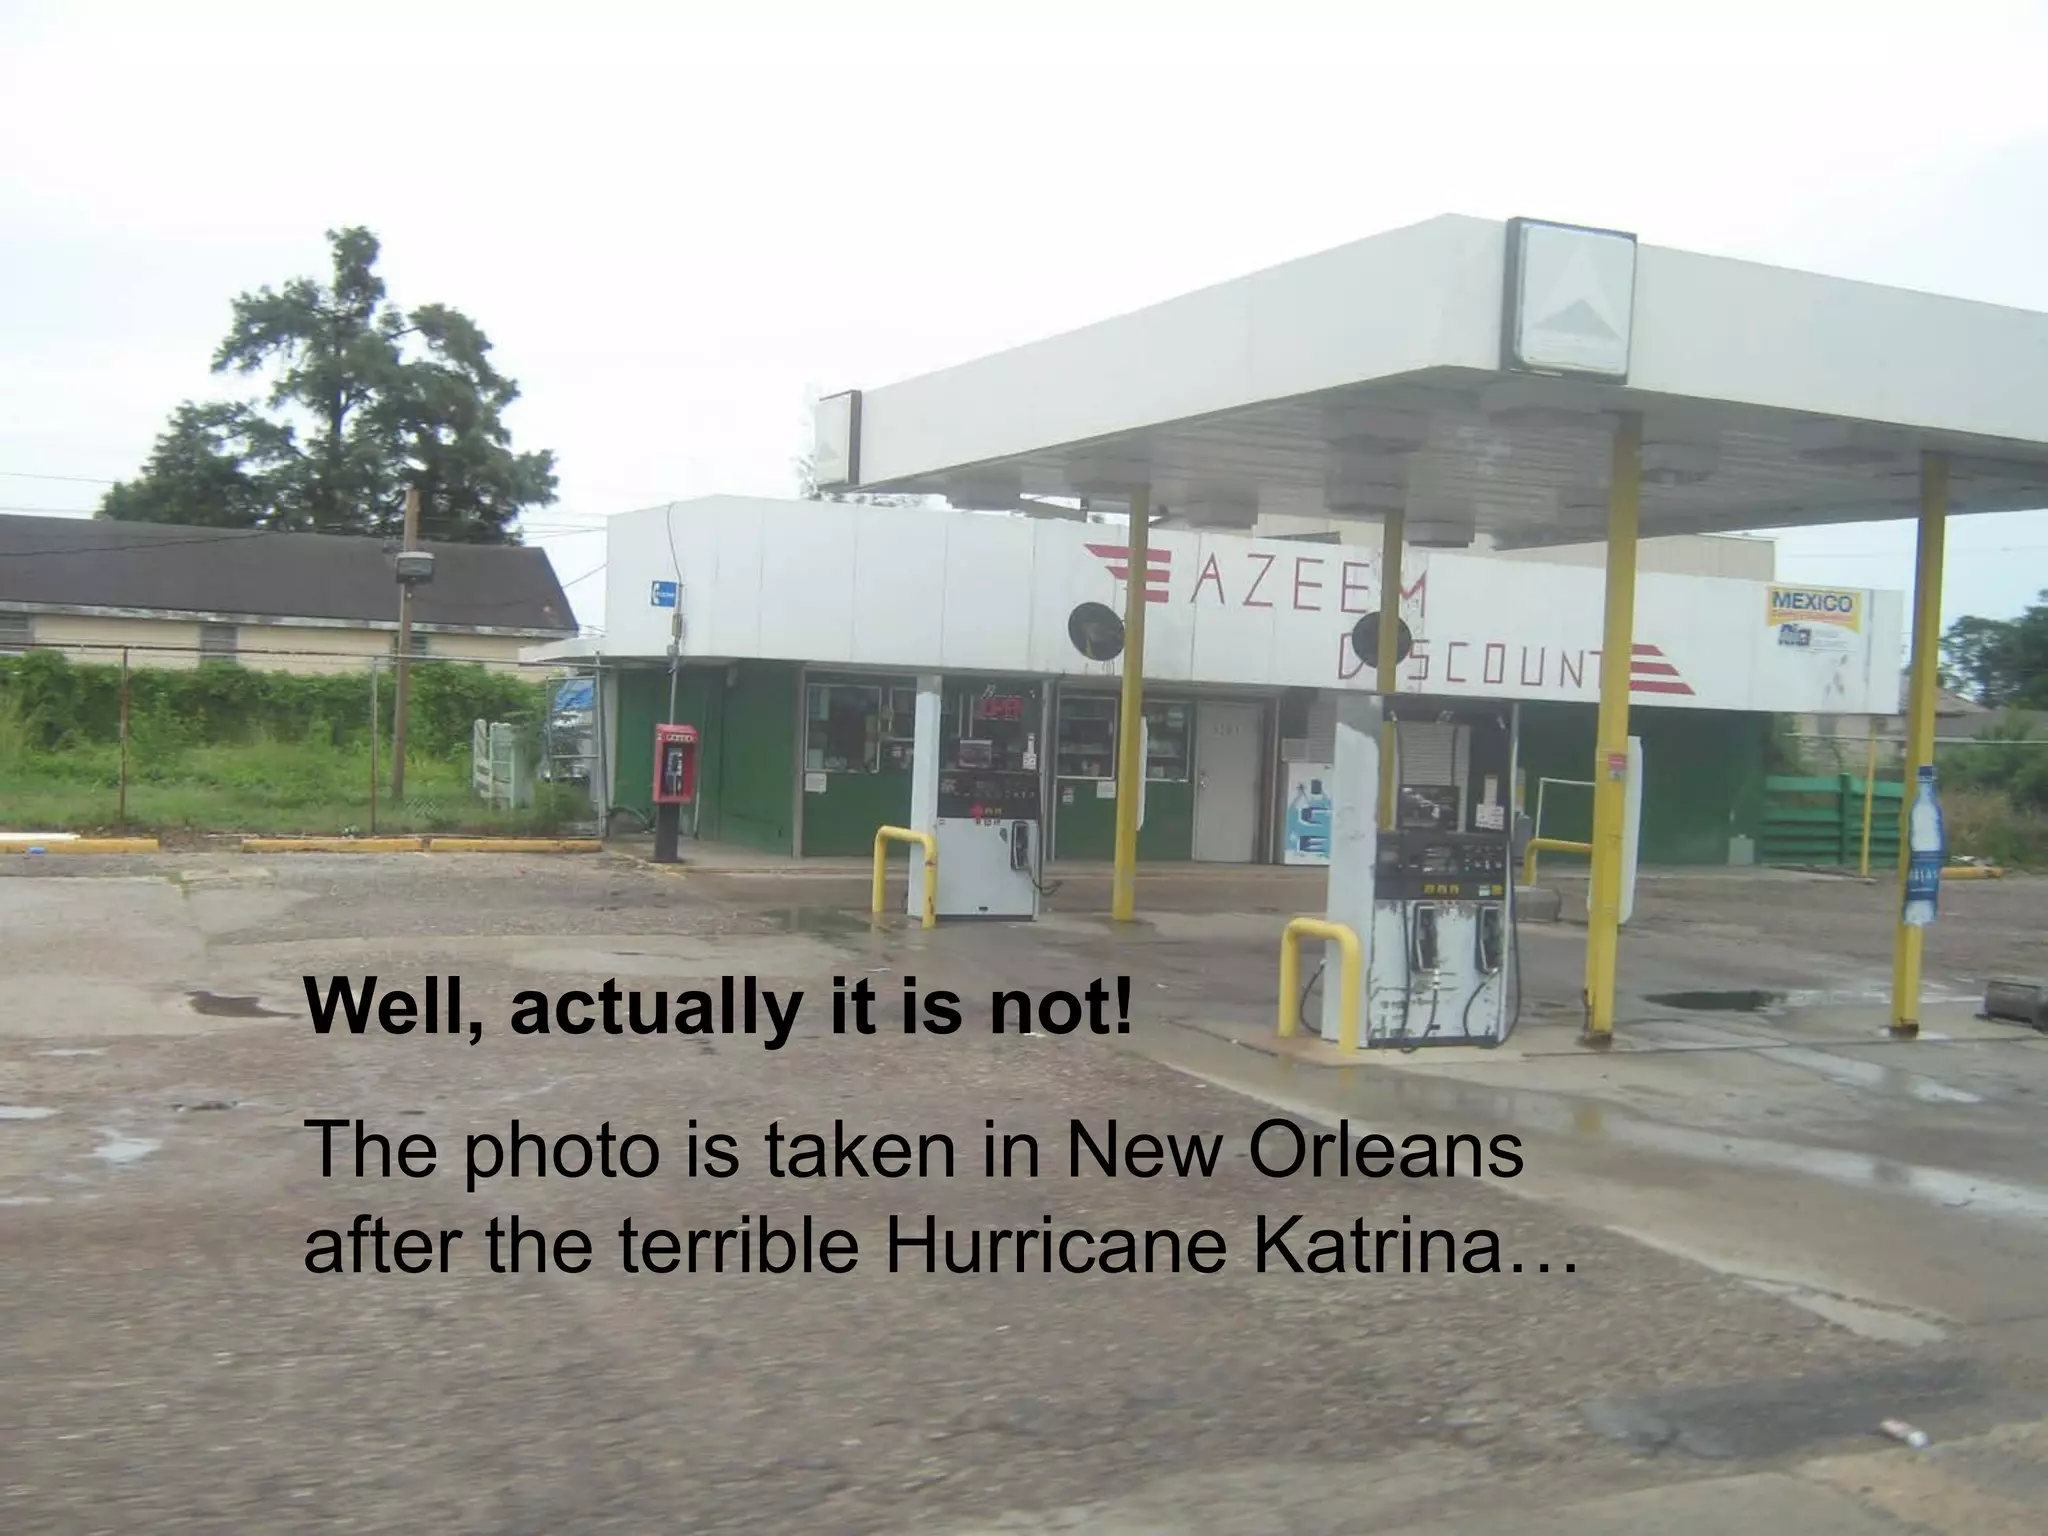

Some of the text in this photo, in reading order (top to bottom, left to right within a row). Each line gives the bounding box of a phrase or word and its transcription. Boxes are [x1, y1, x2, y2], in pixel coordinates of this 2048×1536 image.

[1189, 551, 1428, 618] AZEEM
[1771, 591, 1854, 613] MEXICO
[1338, 632, 1605, 689] DSCOUNT
